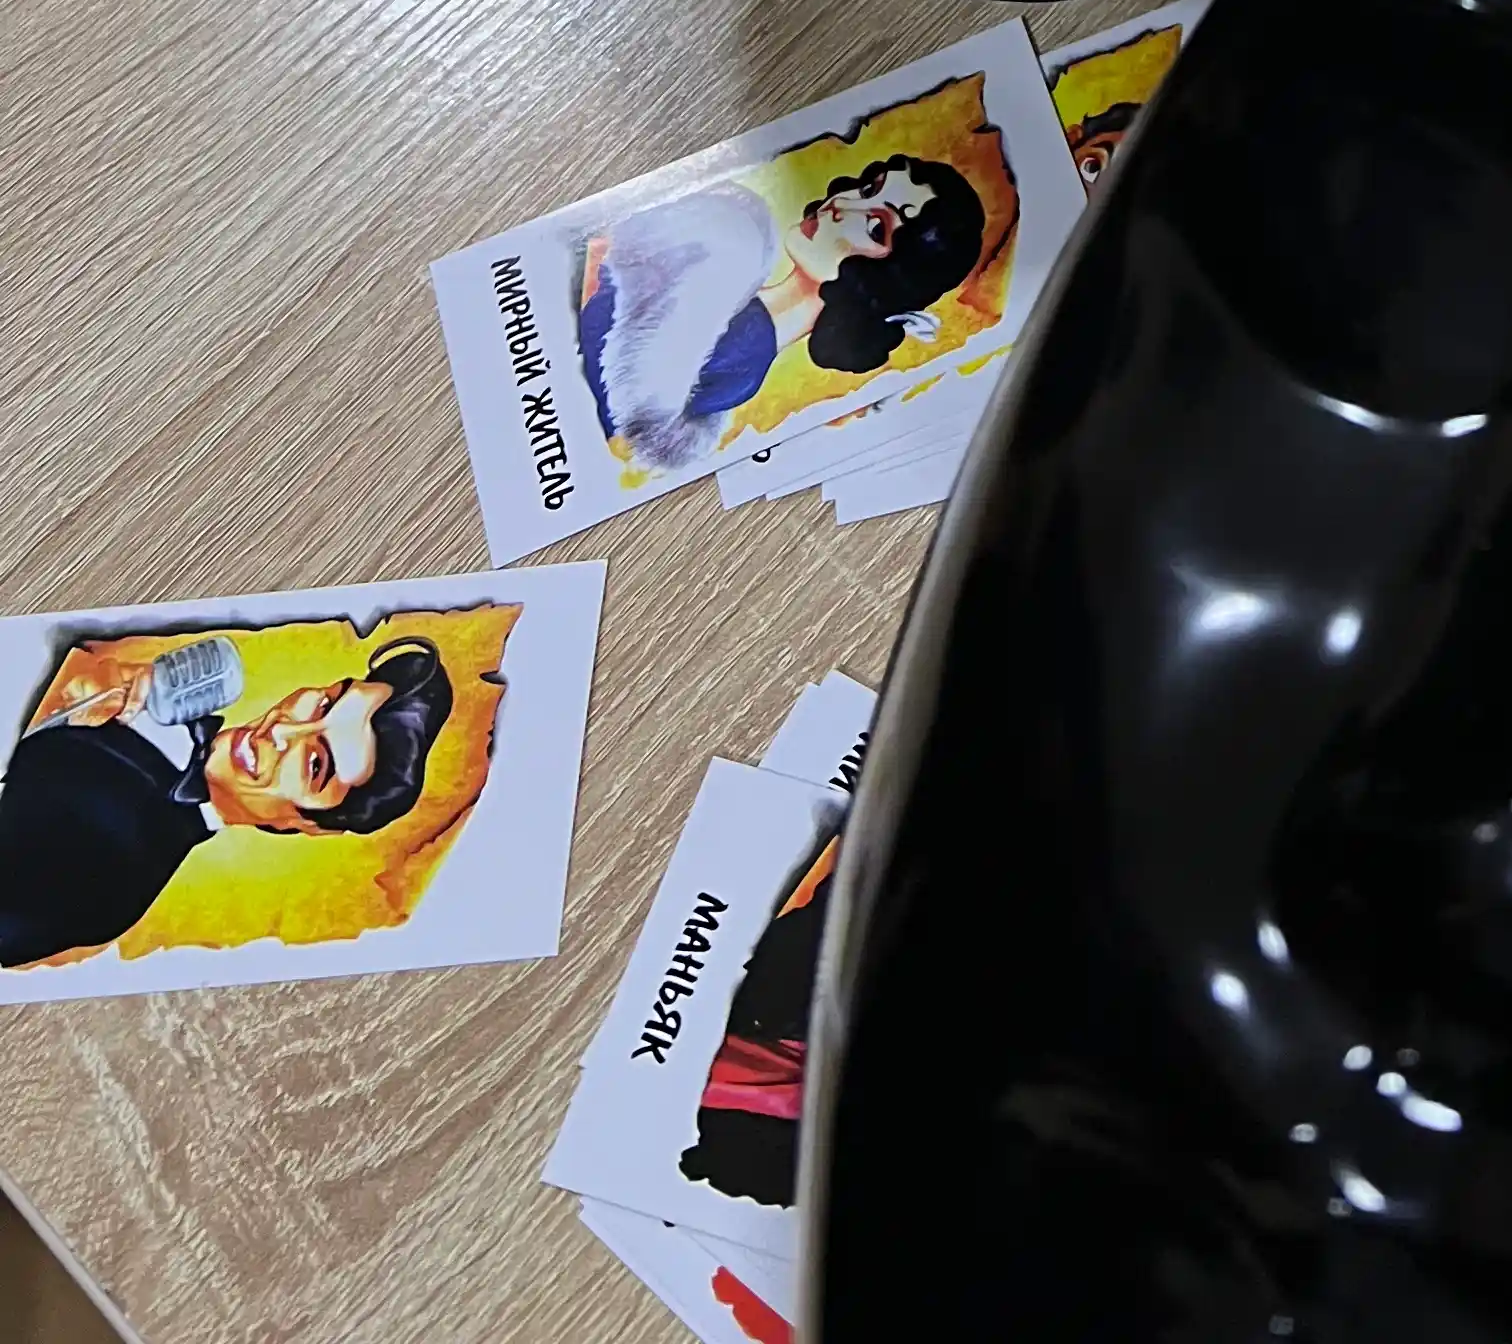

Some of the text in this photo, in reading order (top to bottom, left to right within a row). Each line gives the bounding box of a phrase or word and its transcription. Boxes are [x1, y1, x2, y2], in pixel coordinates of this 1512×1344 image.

[490, 255, 575, 510] МИРНЫЙ ЖИТЕЛЬ
[630, 891, 730, 1064] МАНЬЯК
